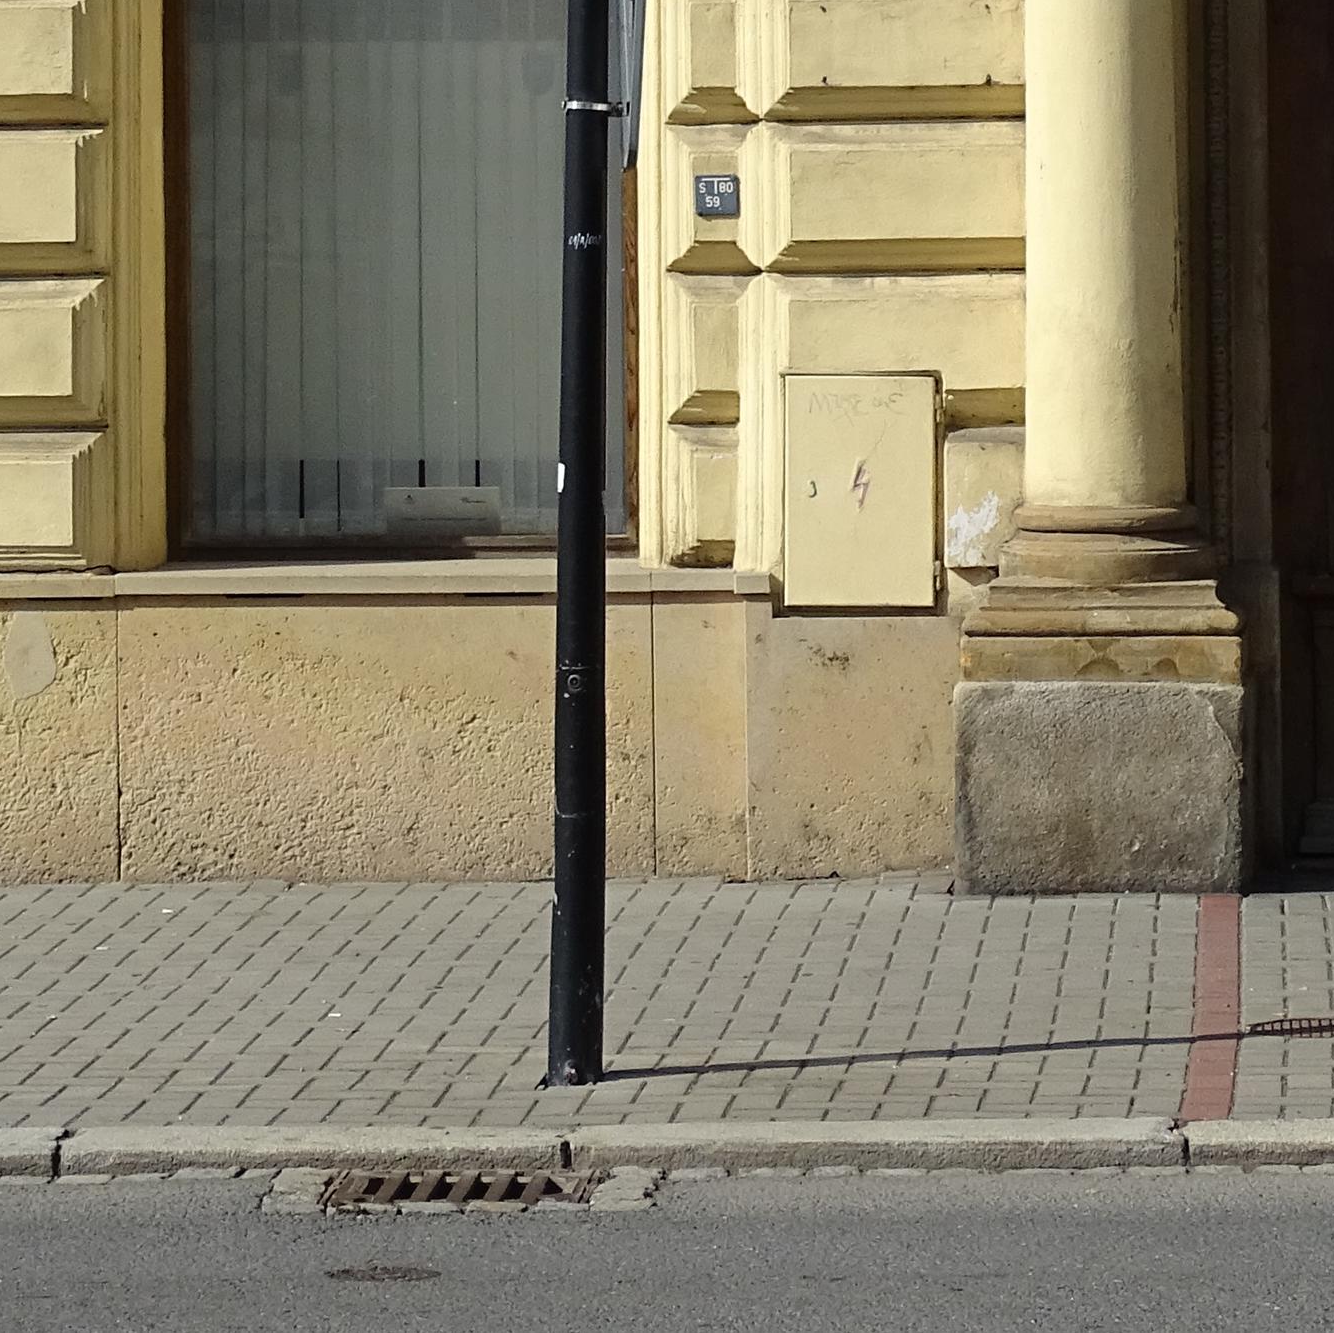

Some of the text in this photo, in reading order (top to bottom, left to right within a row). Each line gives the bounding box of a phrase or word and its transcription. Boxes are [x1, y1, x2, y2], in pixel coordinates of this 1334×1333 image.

[698, 182, 706, 194] S
[718, 182, 734, 193] 80
[705, 196, 720, 207] 59
